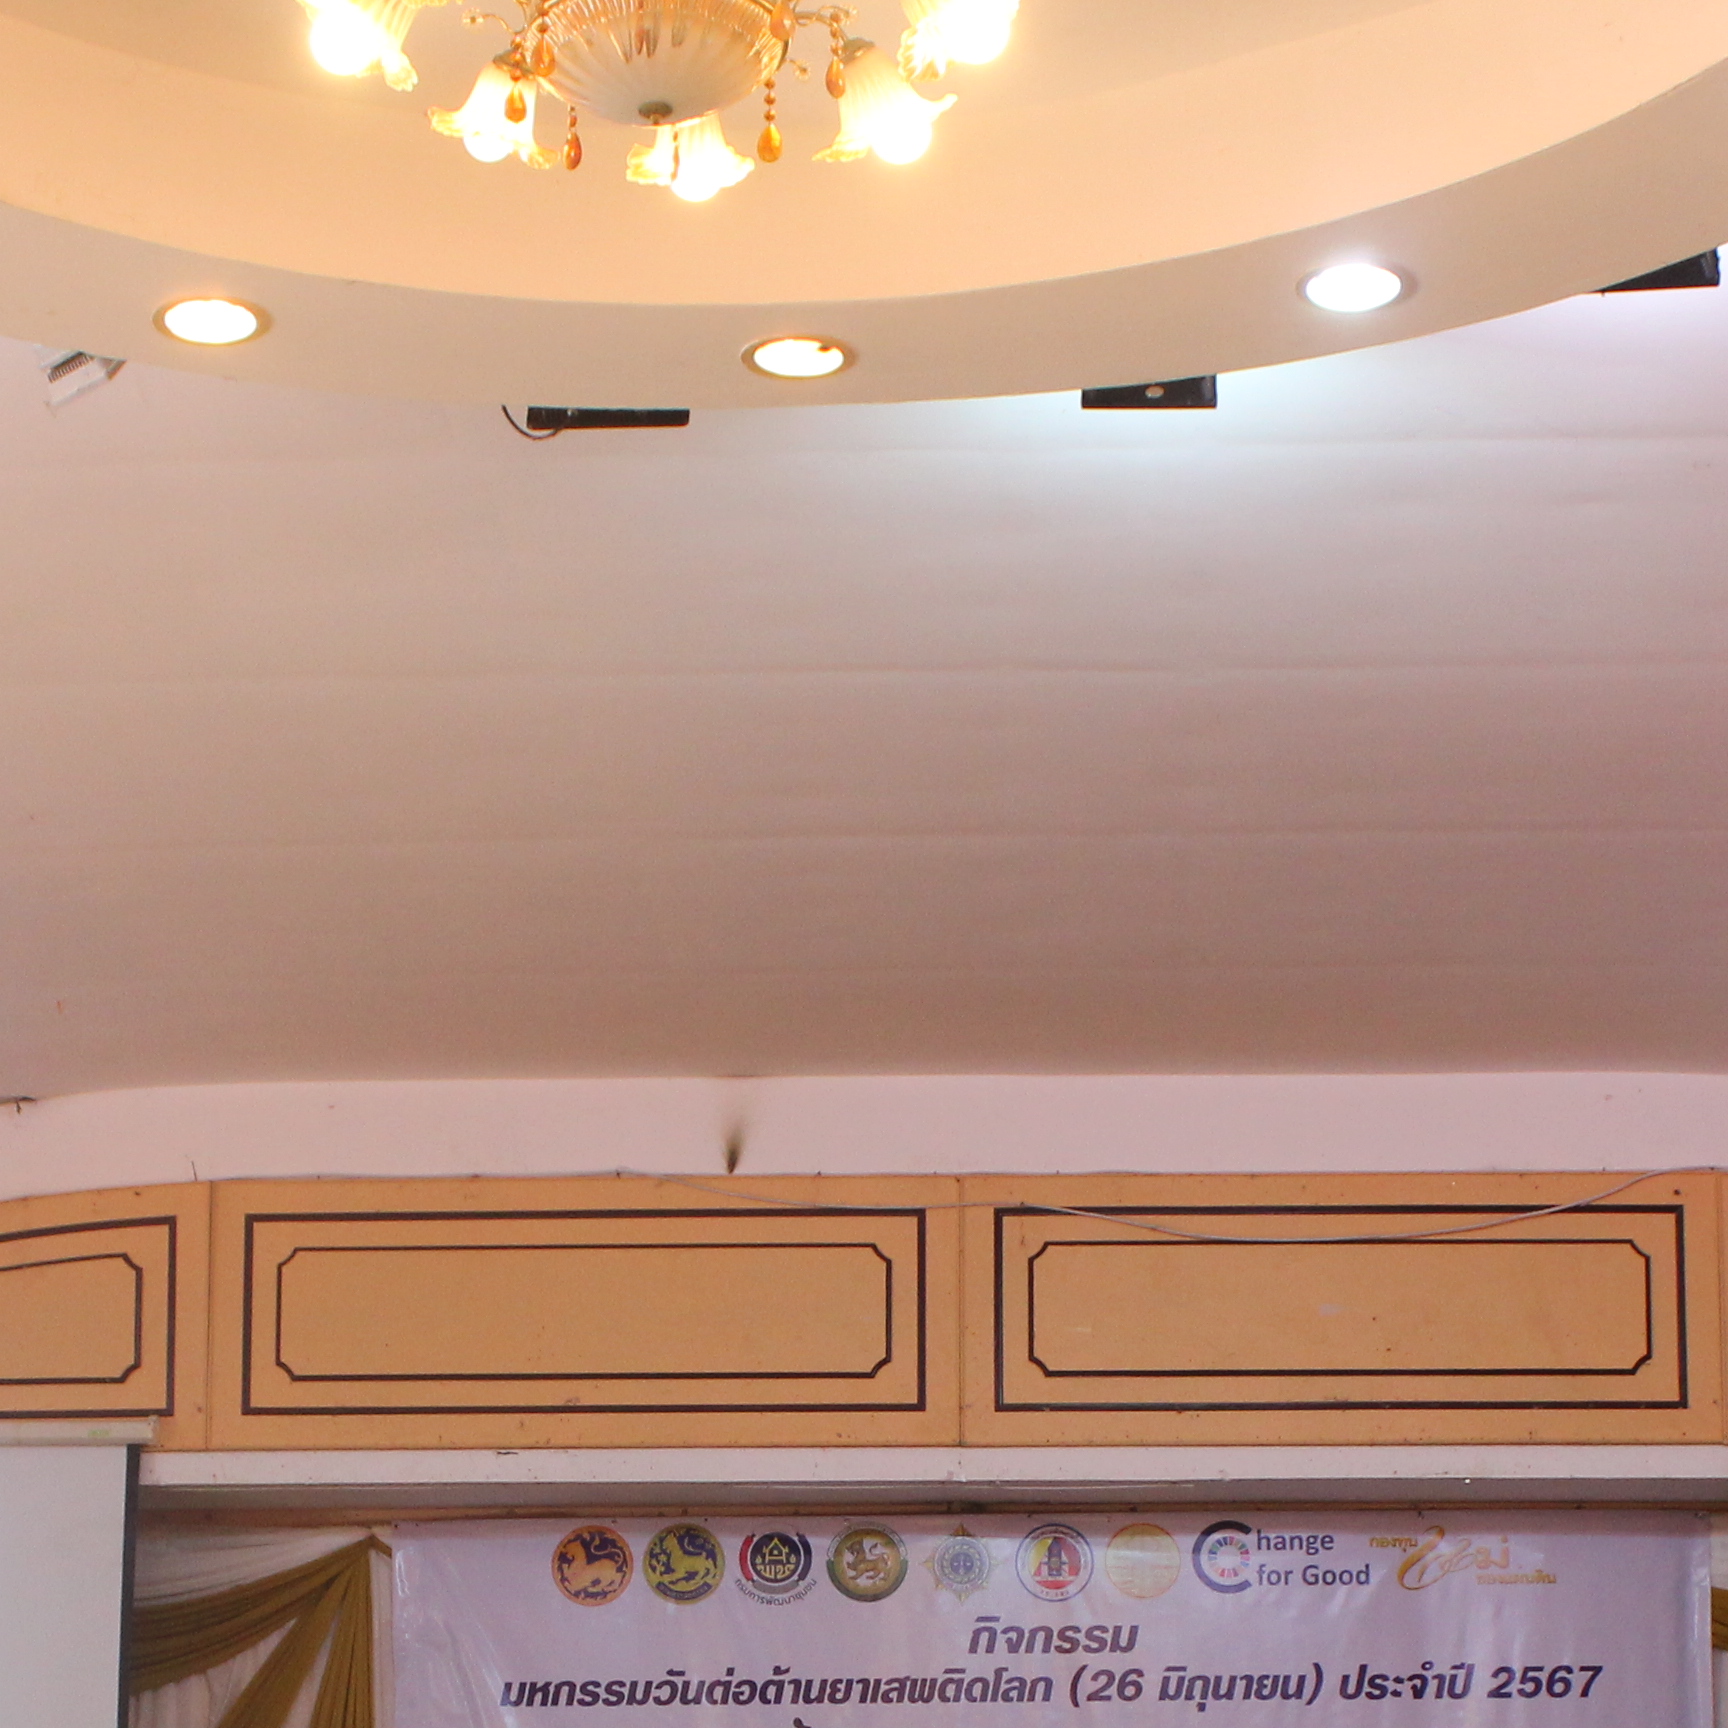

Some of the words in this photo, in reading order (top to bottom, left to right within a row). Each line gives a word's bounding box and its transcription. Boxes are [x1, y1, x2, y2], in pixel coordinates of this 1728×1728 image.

[1256, 1563, 1294, 1586] for
[1302, 1563, 1371, 1587] Good
[968, 1616, 1139, 1655] กิจกรรม
[500, 1666, 1053, 1708] มหกรรมวันต่อต้านยาเสพติดโลก
[1070, 1664, 1144, 1707] (26
[1157, 1663, 1325, 1712] มิถุนายน)
[1339, 1663, 1475, 1701] ประจำปี
[1487, 1665, 1603, 1700] 2567
